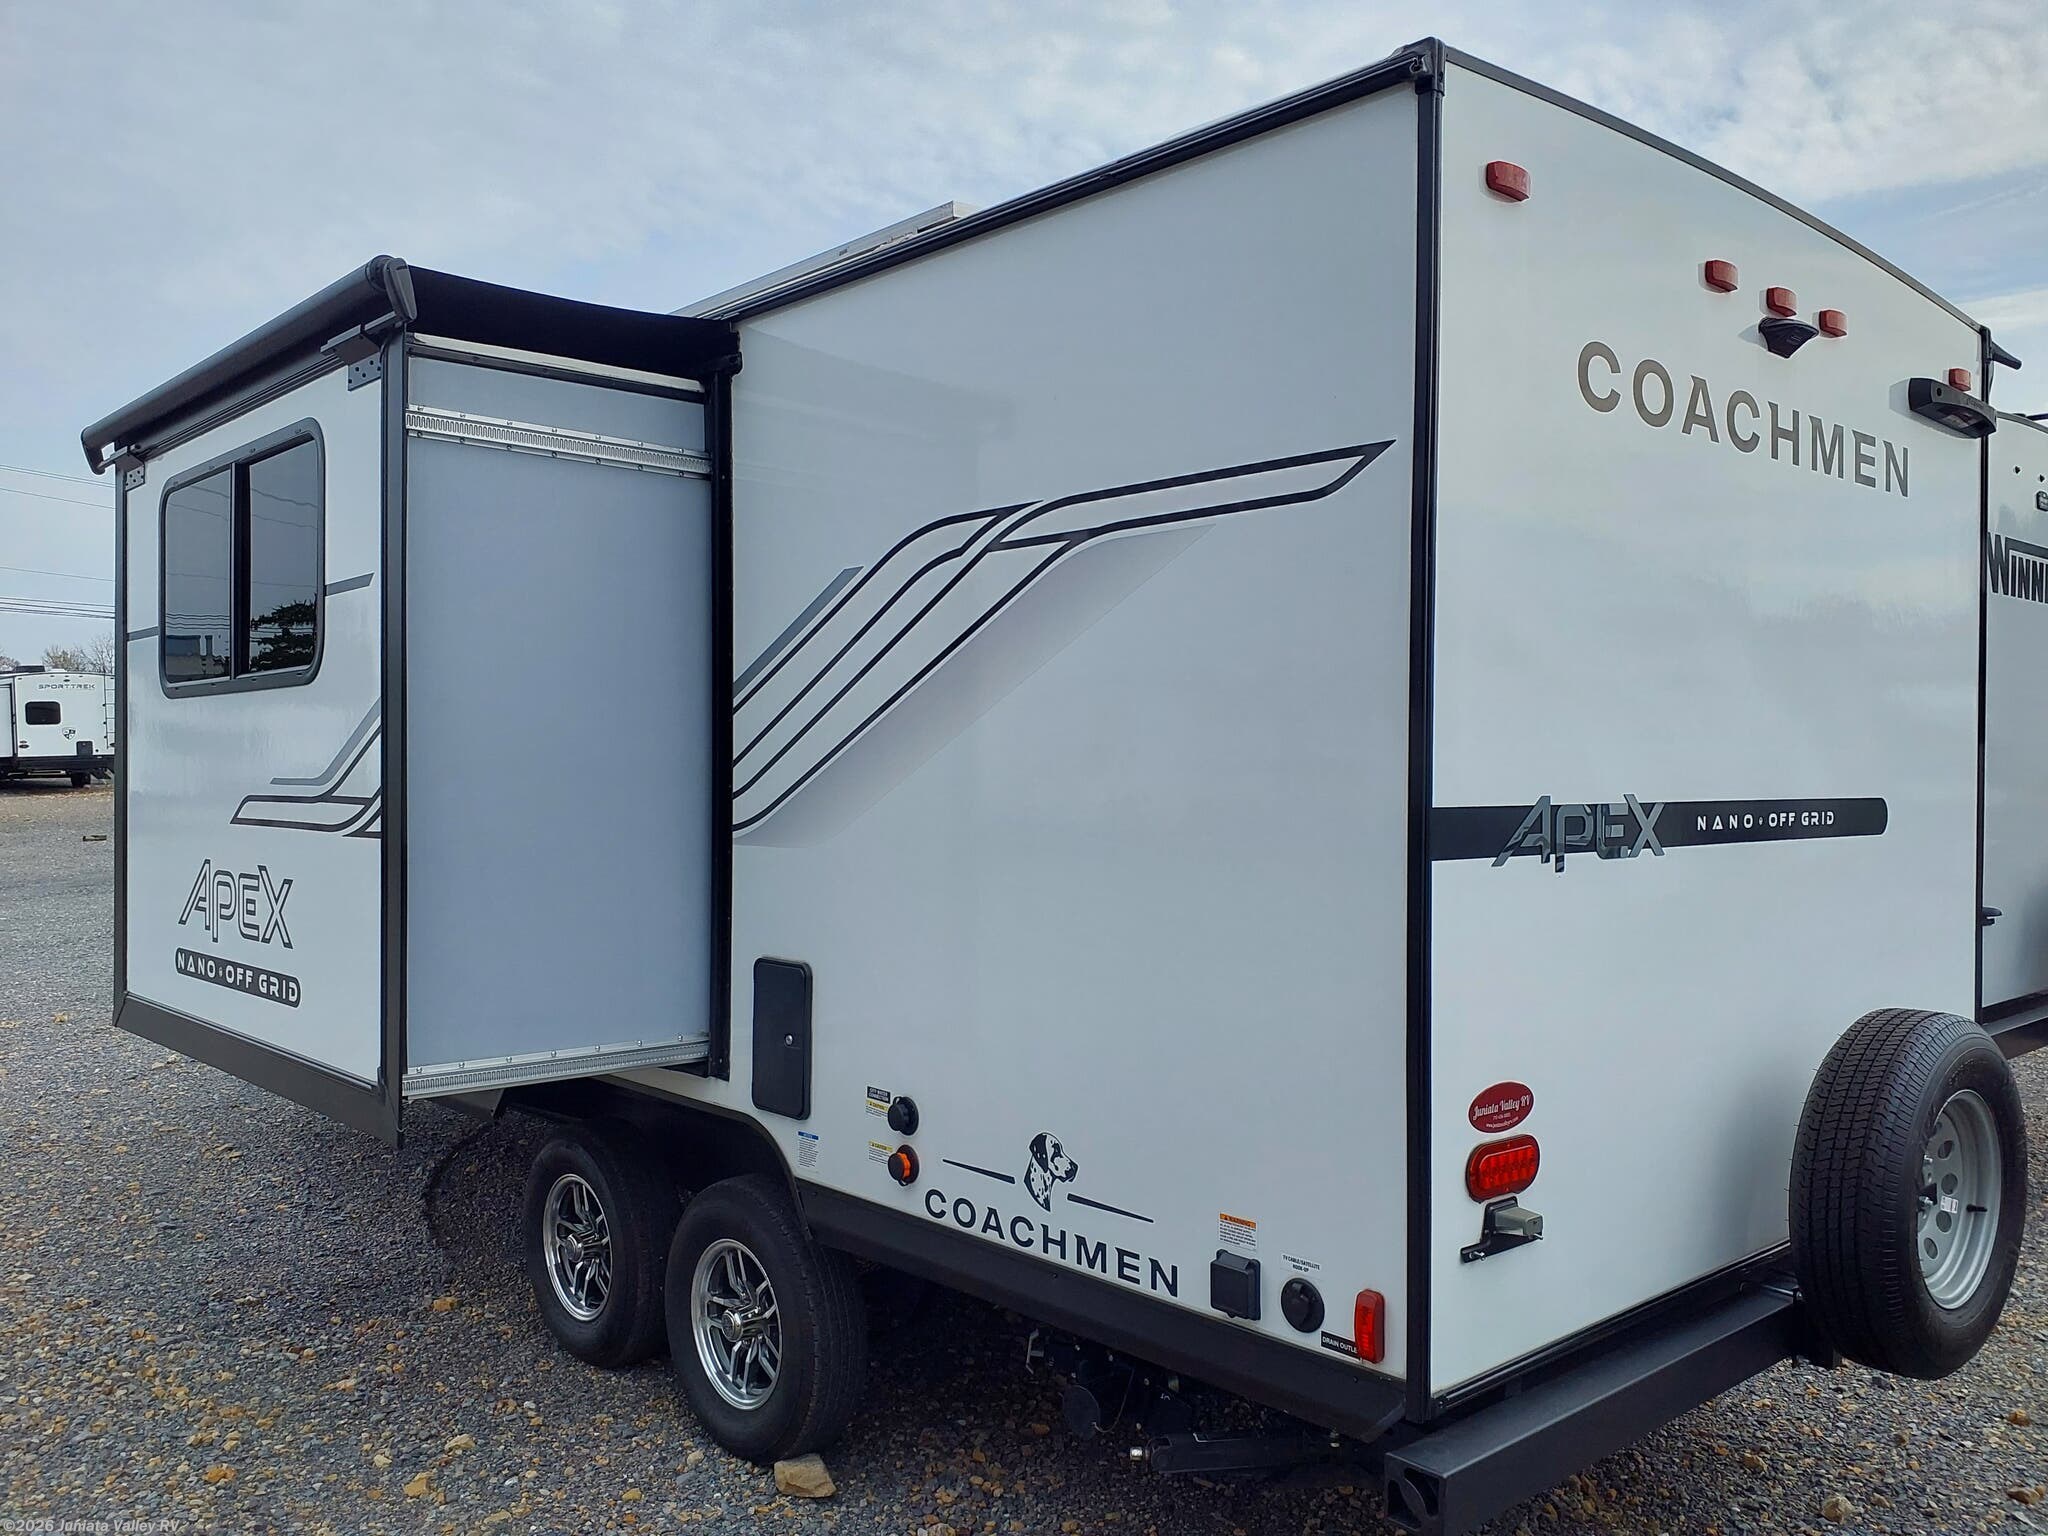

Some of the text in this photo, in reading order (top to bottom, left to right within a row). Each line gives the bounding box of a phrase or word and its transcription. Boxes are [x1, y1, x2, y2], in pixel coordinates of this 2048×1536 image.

[1577, 340, 1909, 498] COACHMEN
[1491, 793, 1665, 872] APEX
[1697, 809, 1835, 831] NANO OFF GRID
[178, 859, 293, 949] APEX
[177, 951, 298, 1002] NANO OFF GRID
[1473, 1104, 1498, 1120] Juniata
[1500, 1099, 1520, 1111] Valley
[1521, 1095, 1531, 1106] RV
[925, 1188, 1178, 1298] COACHMEN
[1322, 1336, 1358, 1354] DRAIN OUTLE
